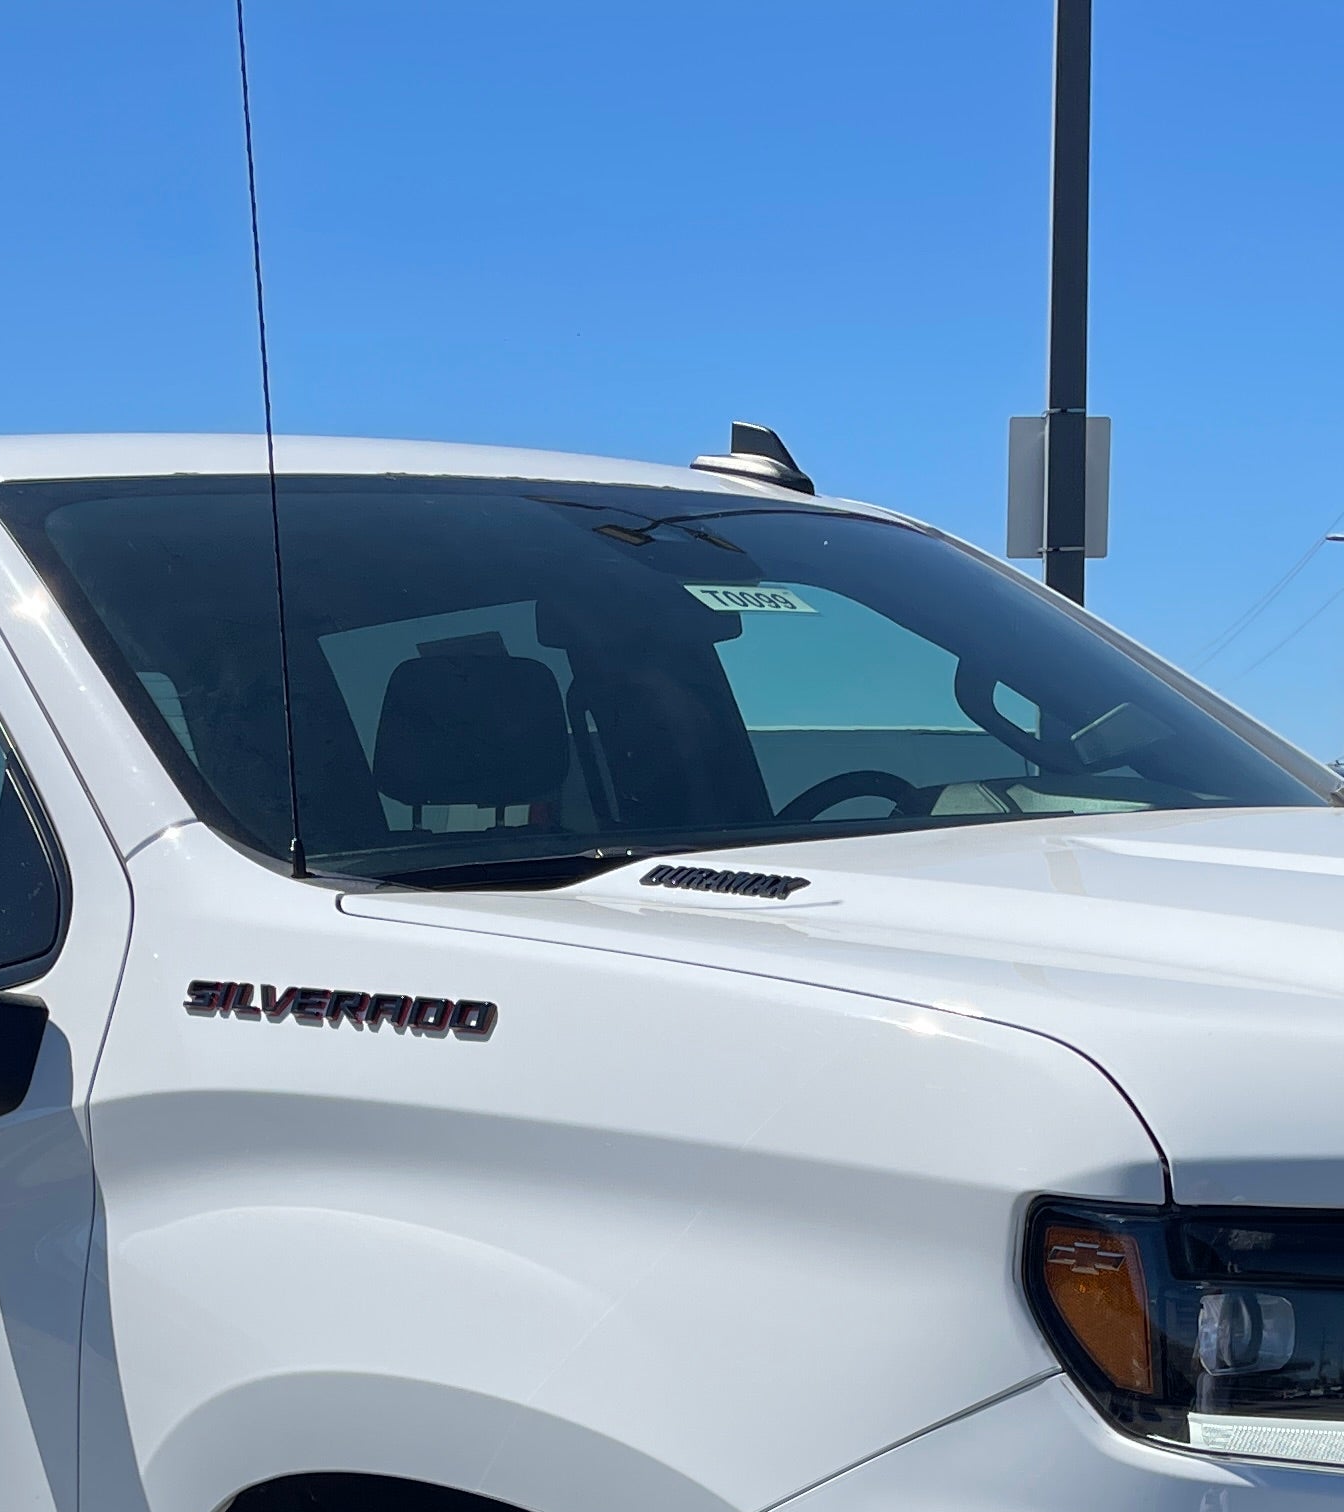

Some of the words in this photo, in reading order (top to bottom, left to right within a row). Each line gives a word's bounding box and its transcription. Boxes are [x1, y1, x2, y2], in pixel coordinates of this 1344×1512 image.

[701, 590, 797, 610] T0099
[641, 864, 811, 900] DURAMAX
[184, 980, 498, 1041] SILVERADO
